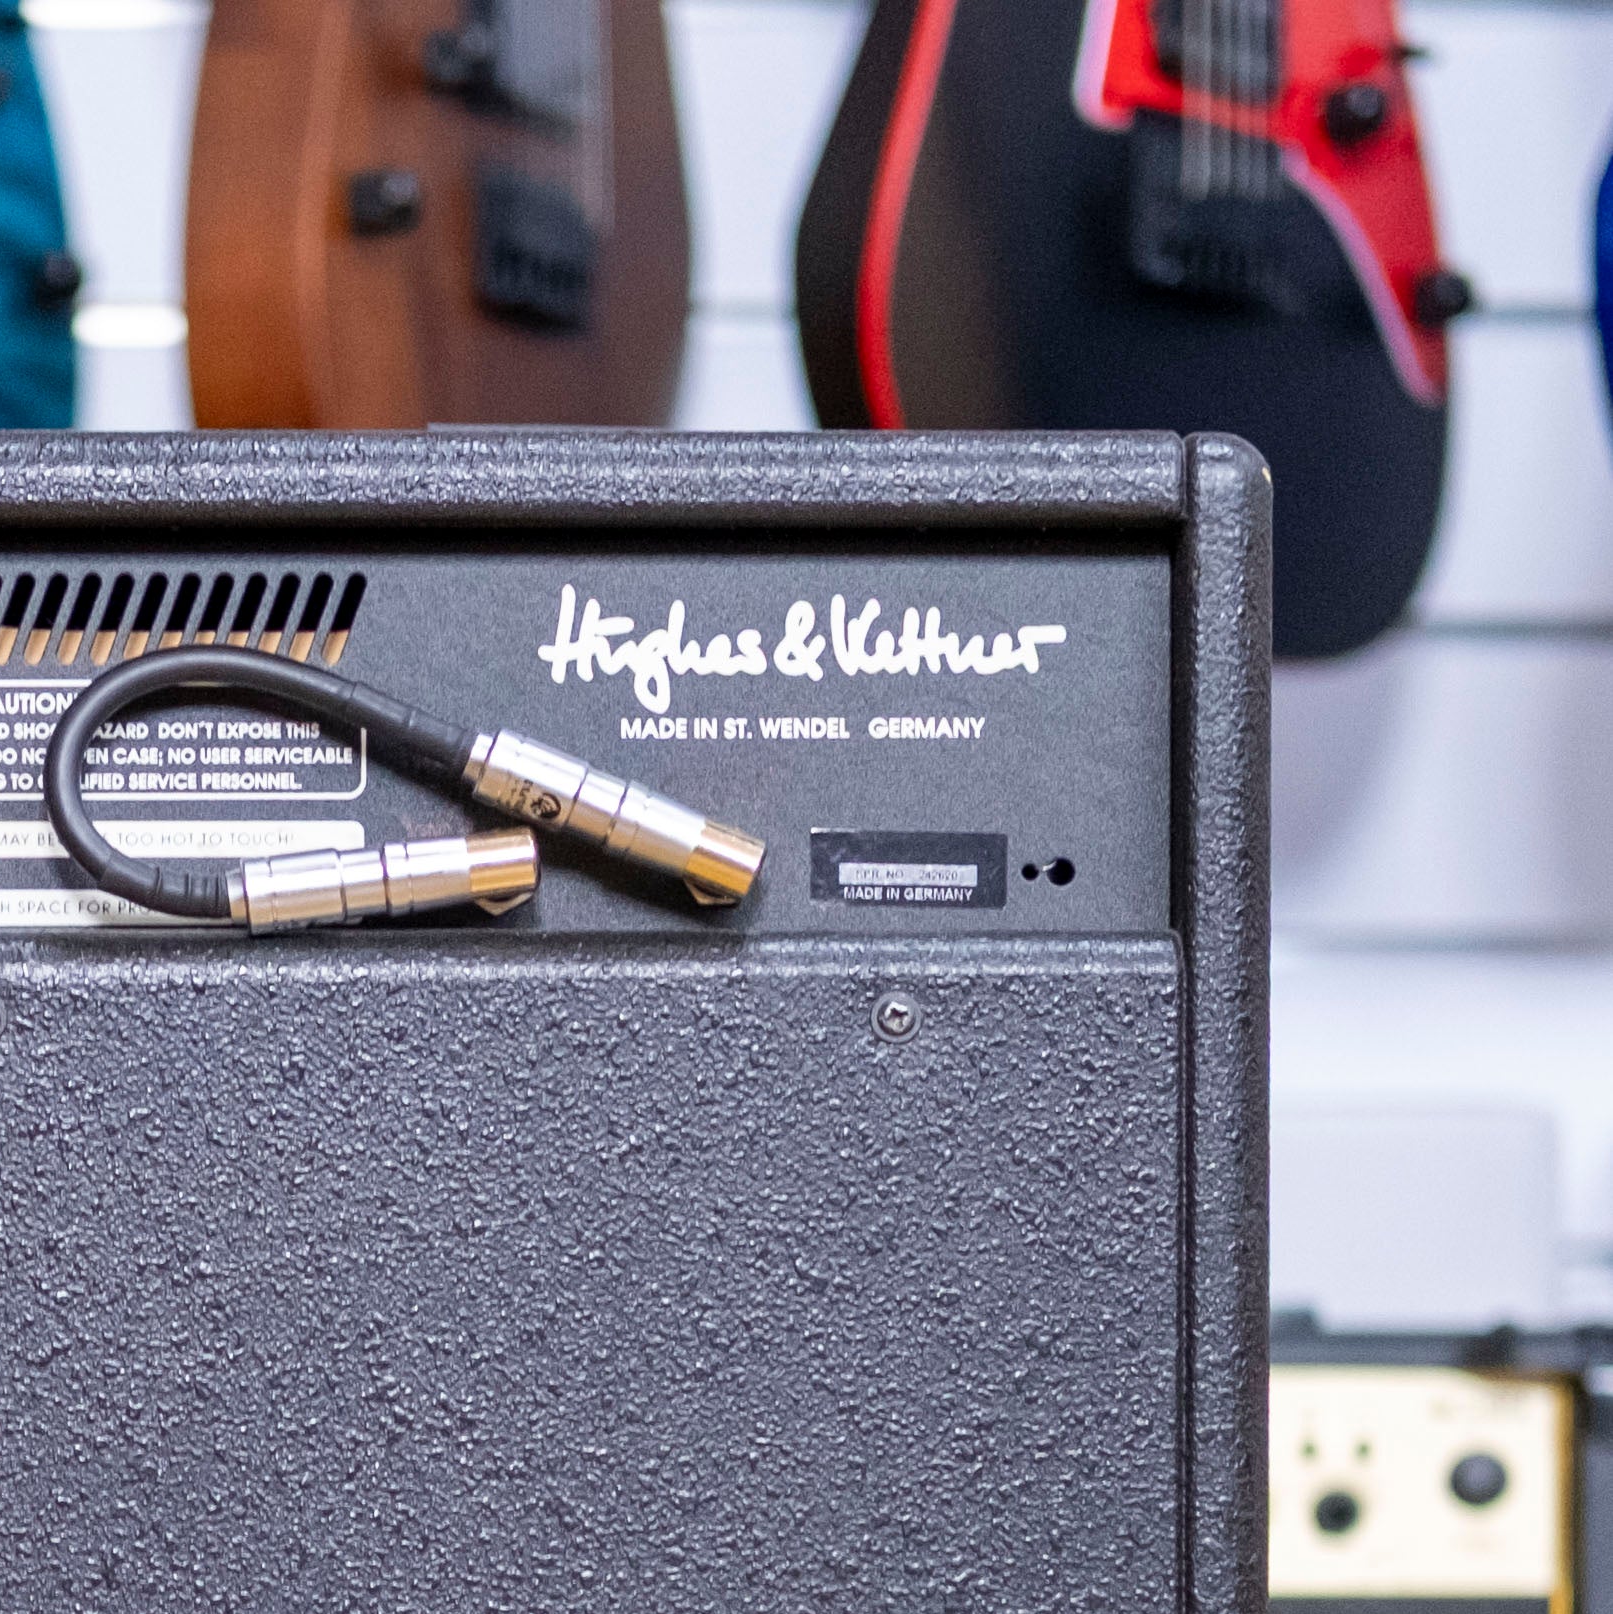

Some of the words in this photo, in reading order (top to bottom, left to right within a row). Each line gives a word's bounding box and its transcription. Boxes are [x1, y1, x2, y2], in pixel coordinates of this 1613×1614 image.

[538, 584, 767, 714] Hughes
[774, 600, 826, 681] &
[830, 594, 1067, 676] Kettner
[92, 722, 150, 740] AZARD
[157, 721, 214, 740] DON'T
[217, 722, 282, 740] EXPOSE
[285, 722, 321, 740] THIS
[620, 717, 688, 739] MADE
[693, 717, 718, 739] IN
[723, 717, 753, 739] ST.
[759, 716, 851, 739] WENDEL
[868, 716, 986, 739] GERMANY
[112, 747, 164, 768] CASE;
[167, 747, 196, 765] NO
[199, 747, 241, 765] USER
[243, 747, 353, 765] SERVICEABLE
[10, 772, 34, 791] TO
[128, 772, 198, 791] SERVICE
[200, 772, 303, 791] PERSONNEL.
[117, 832, 154, 847] TOO
[161, 832, 195, 847] HOT
[200, 832, 224, 847] TO
[843, 886, 883, 900] MADE
[886, 887, 900, 901] IN
[903, 887, 974, 901] GERMANY
[17, 900, 69, 915] SPACE
[78, 901, 111, 917] FOR
